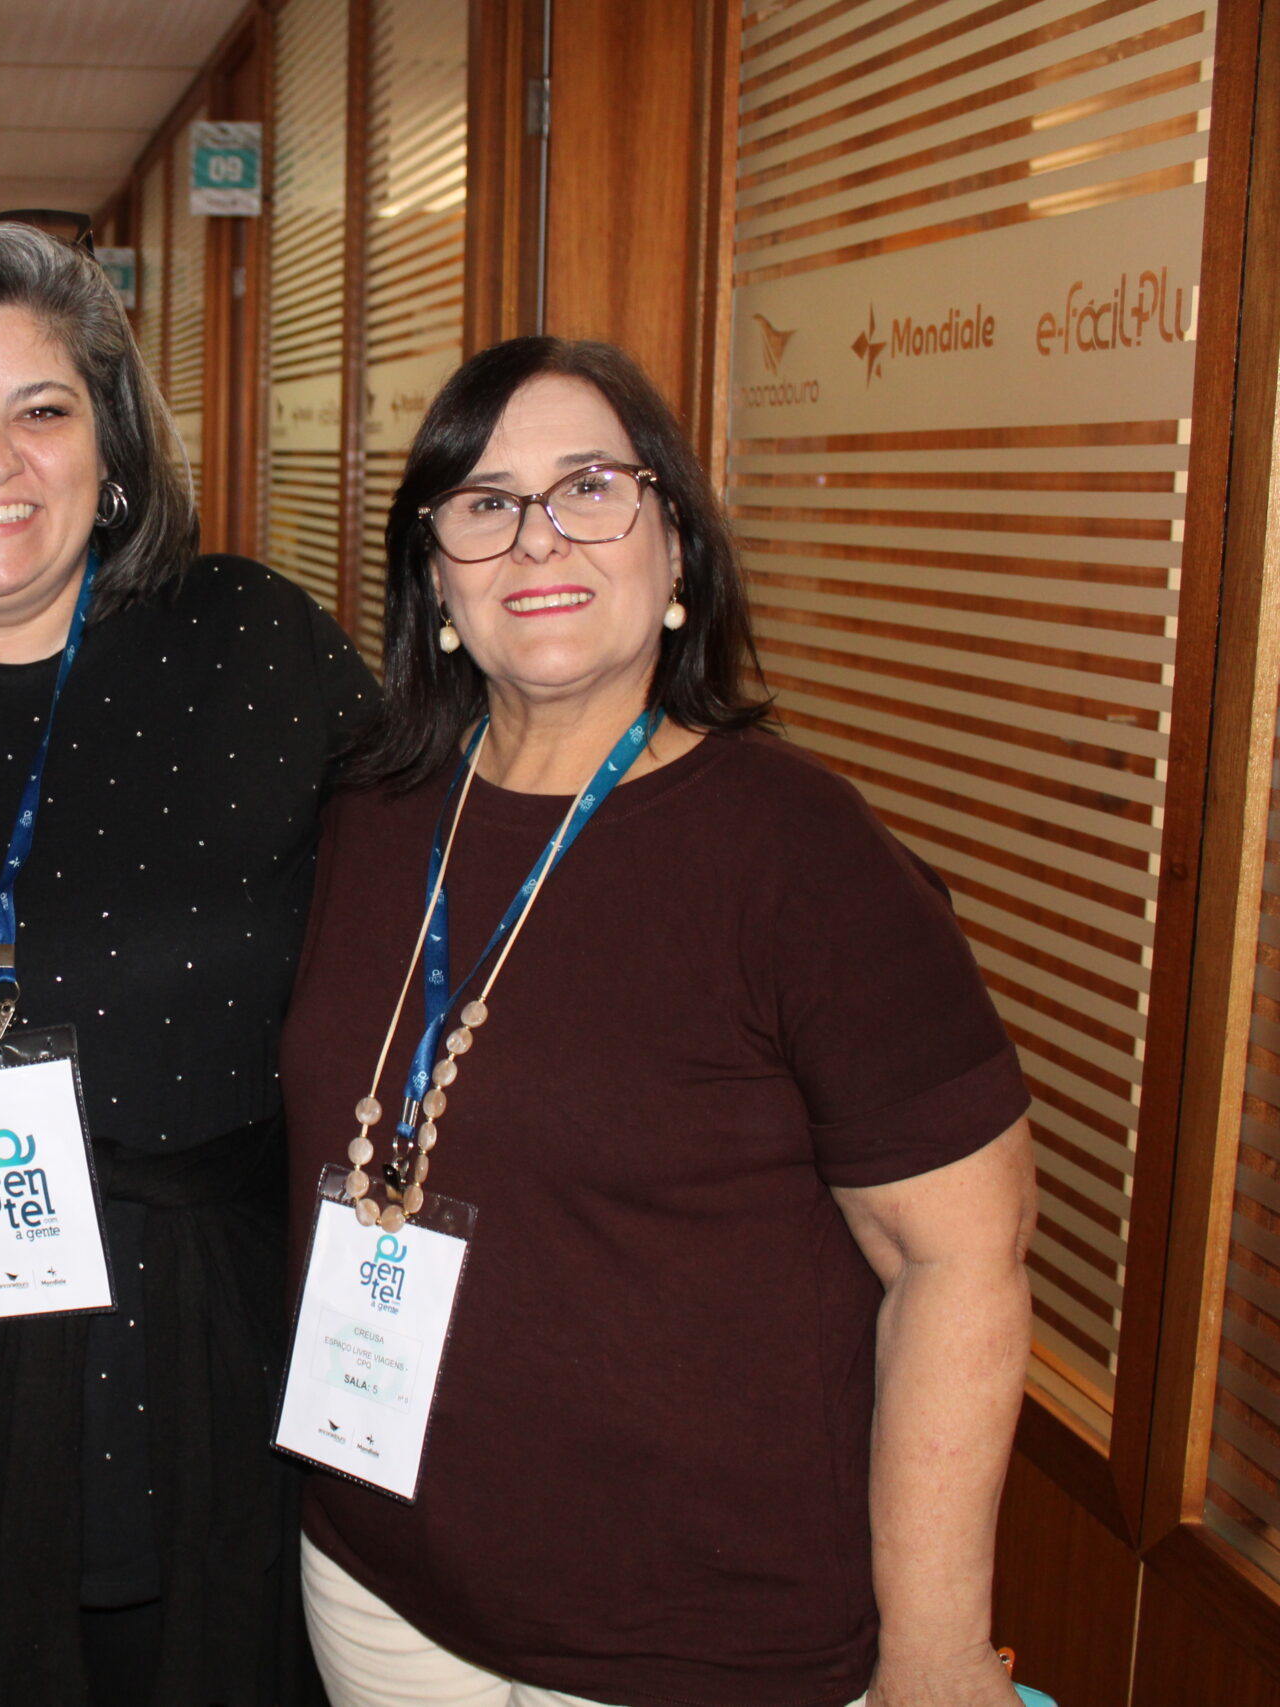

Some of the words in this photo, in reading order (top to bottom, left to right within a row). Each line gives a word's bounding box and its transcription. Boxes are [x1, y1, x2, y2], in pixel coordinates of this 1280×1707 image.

[208, 155, 243, 182] 09
[891, 303, 995, 359] Mondiale
[15, 1230, 23, 1240] a
[26, 1226, 61, 1242] gente
[353, 1327, 385, 1345] CREUSA
[324, 1336, 353, 1353] ESPAÇO
[352, 1345, 373, 1360] LIVRE
[373, 1353, 405, 1372] VIAGENS
[343, 1374, 371, 1392] SALA:
[372, 1384, 379, 1395] 5
